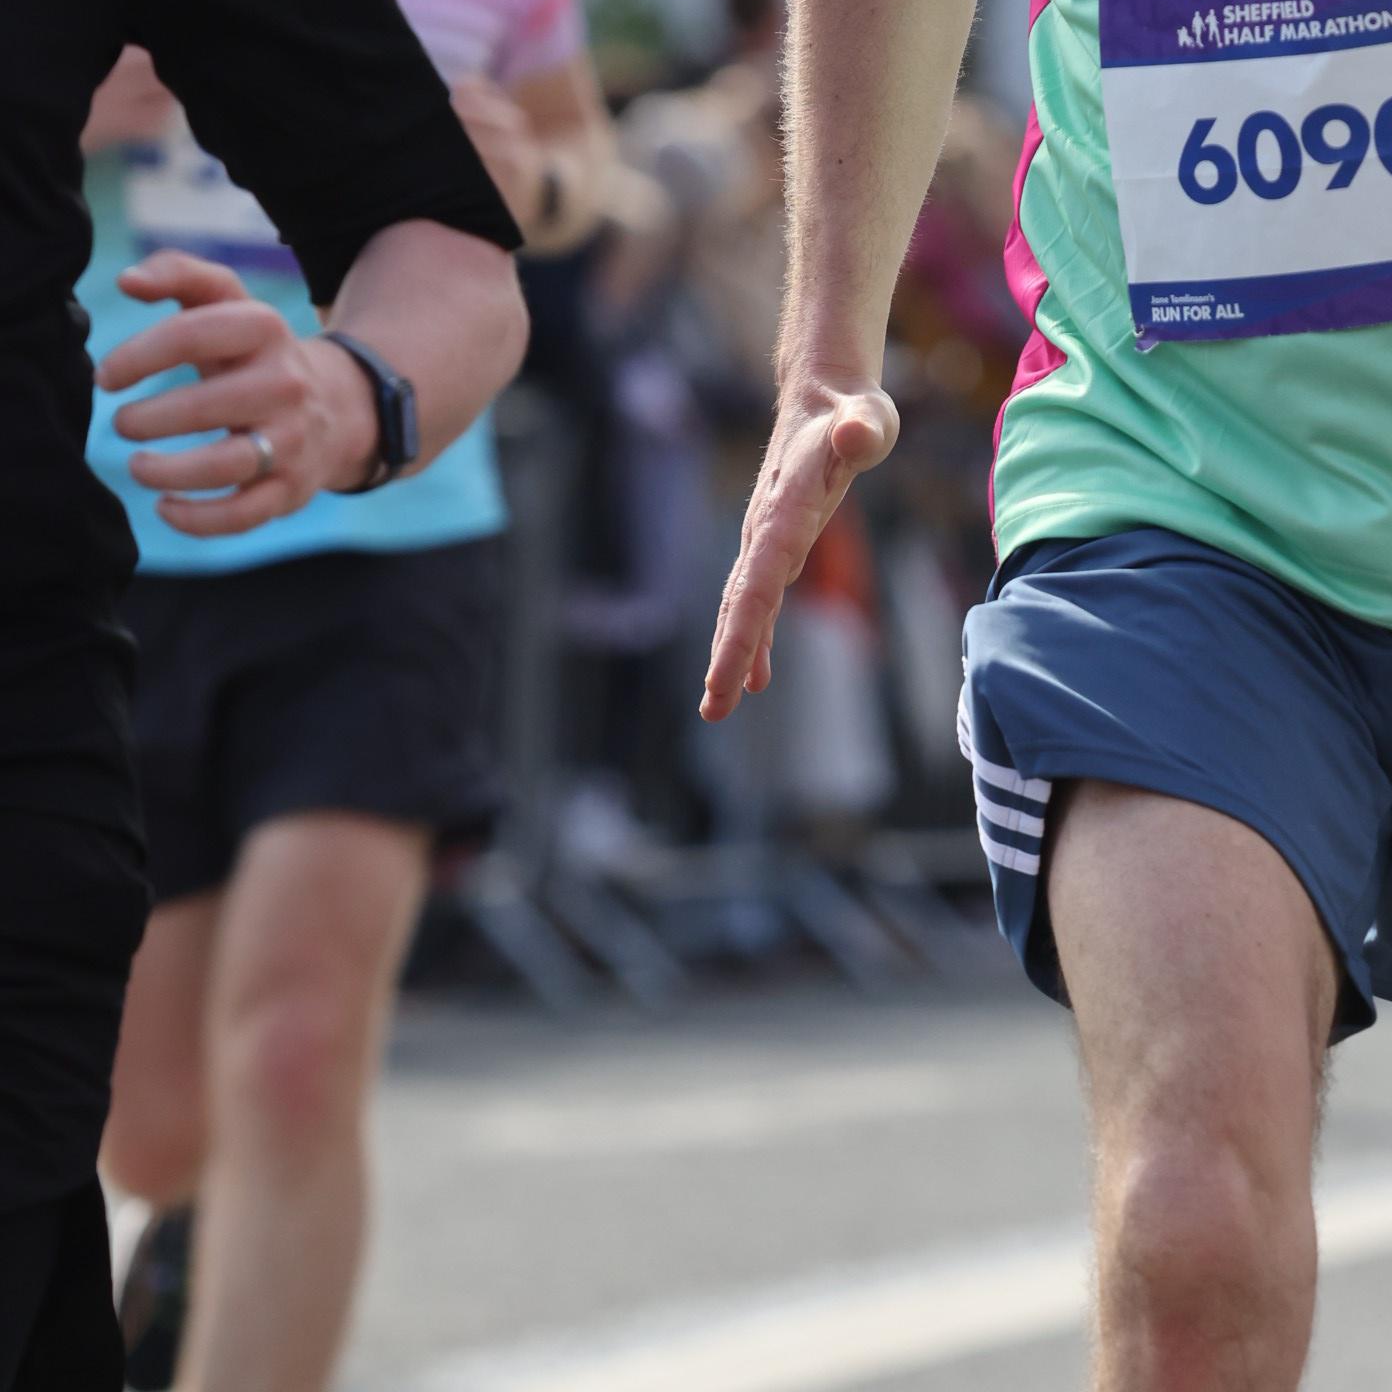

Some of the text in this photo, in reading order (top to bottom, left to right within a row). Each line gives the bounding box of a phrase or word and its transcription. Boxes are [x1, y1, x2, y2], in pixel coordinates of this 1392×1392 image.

[1223, 0, 1315, 24] SHEFFIELD
[1224, 24, 1275, 46] HALF
[1152, 302, 1244, 322] RUN FOR ALL
